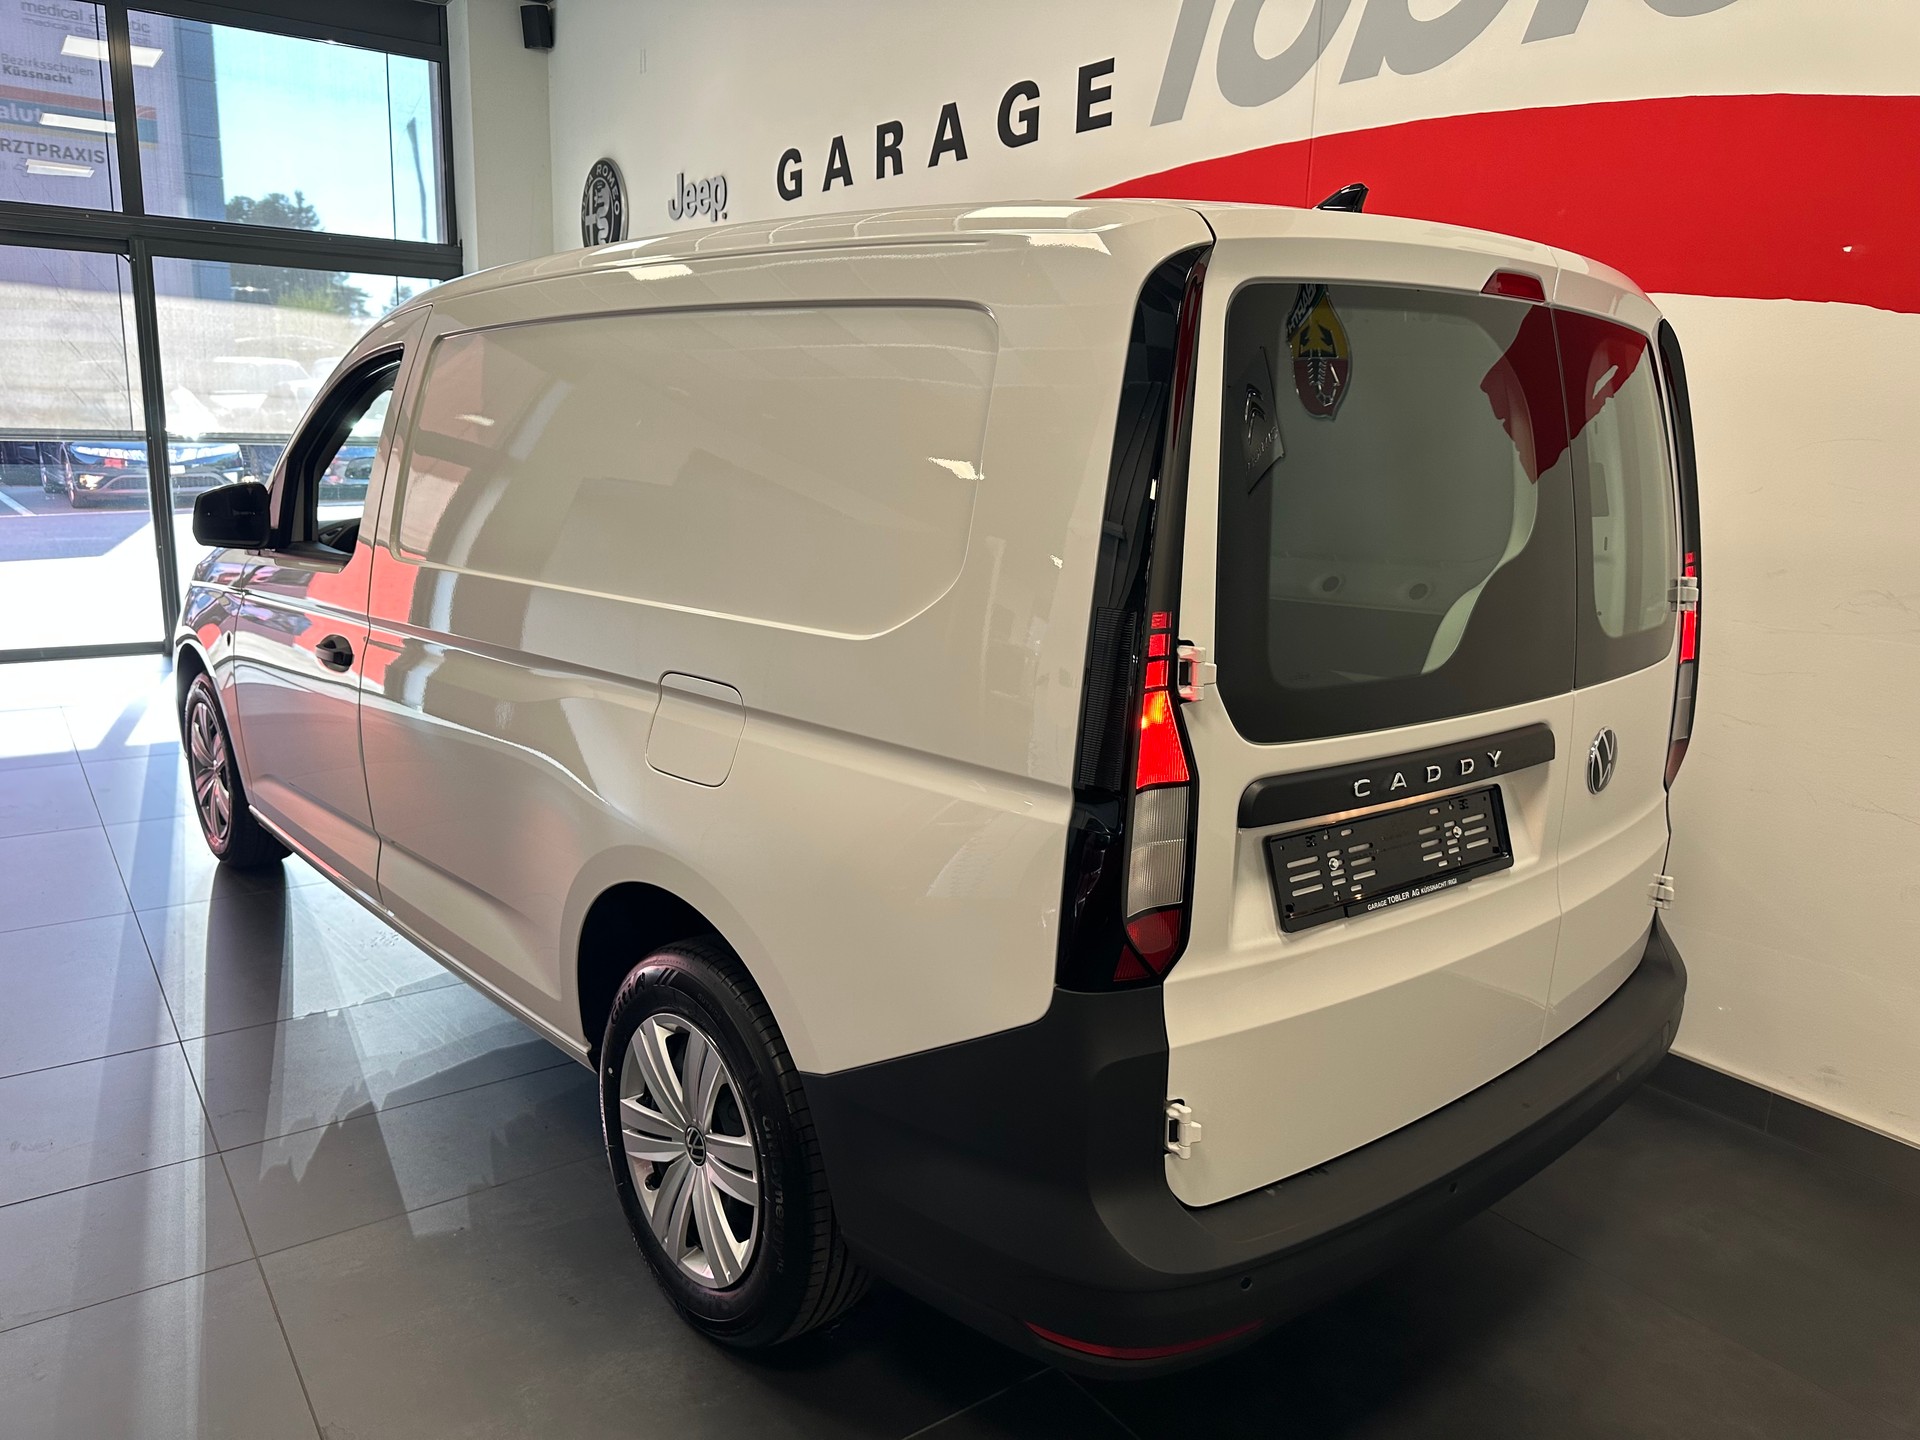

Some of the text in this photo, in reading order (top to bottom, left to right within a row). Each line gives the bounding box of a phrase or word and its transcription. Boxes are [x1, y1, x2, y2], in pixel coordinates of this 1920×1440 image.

[20, 1, 83, 21] medical
[1, 53, 94, 76] Bezirksschulen
[3, 65, 73, 84] Küssnacht
[776, 57, 1115, 201] GARAGE
[0, 137, 105, 164] RZTPRAXIS
[596, 164, 620, 216] ROMEO
[667, 172, 727, 223] Jeep
[1354, 750, 1502, 798] CADDY
[1367, 899, 1387, 911] GARAGE
[1387, 891, 1410, 904] TOBLER
[1411, 888, 1420, 897] AG
